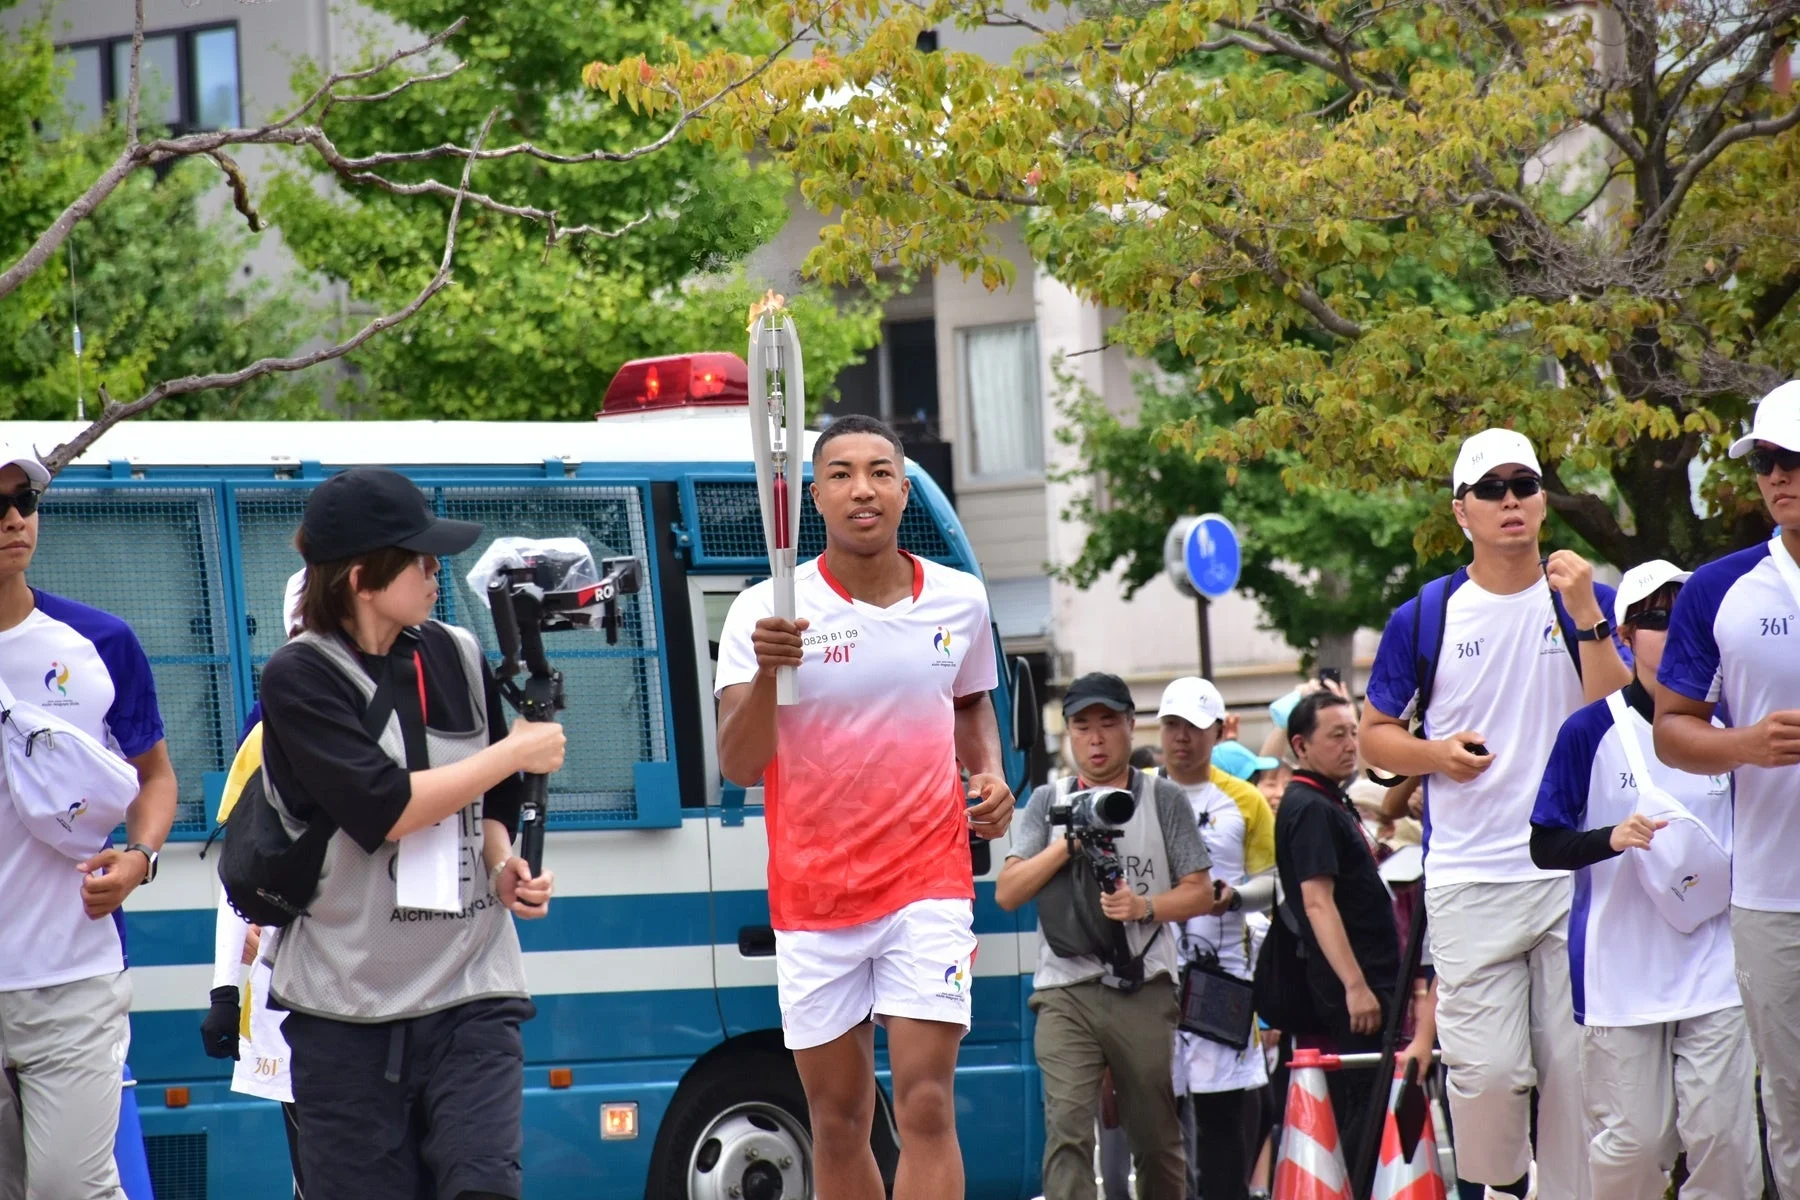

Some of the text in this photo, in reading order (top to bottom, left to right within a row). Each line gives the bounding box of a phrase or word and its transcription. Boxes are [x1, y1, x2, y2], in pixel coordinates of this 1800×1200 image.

[594, 584, 615, 602] RO
[803, 634, 828, 646] 0829
[845, 629, 858, 639] 09
[1619, 772, 1638, 789] 36
